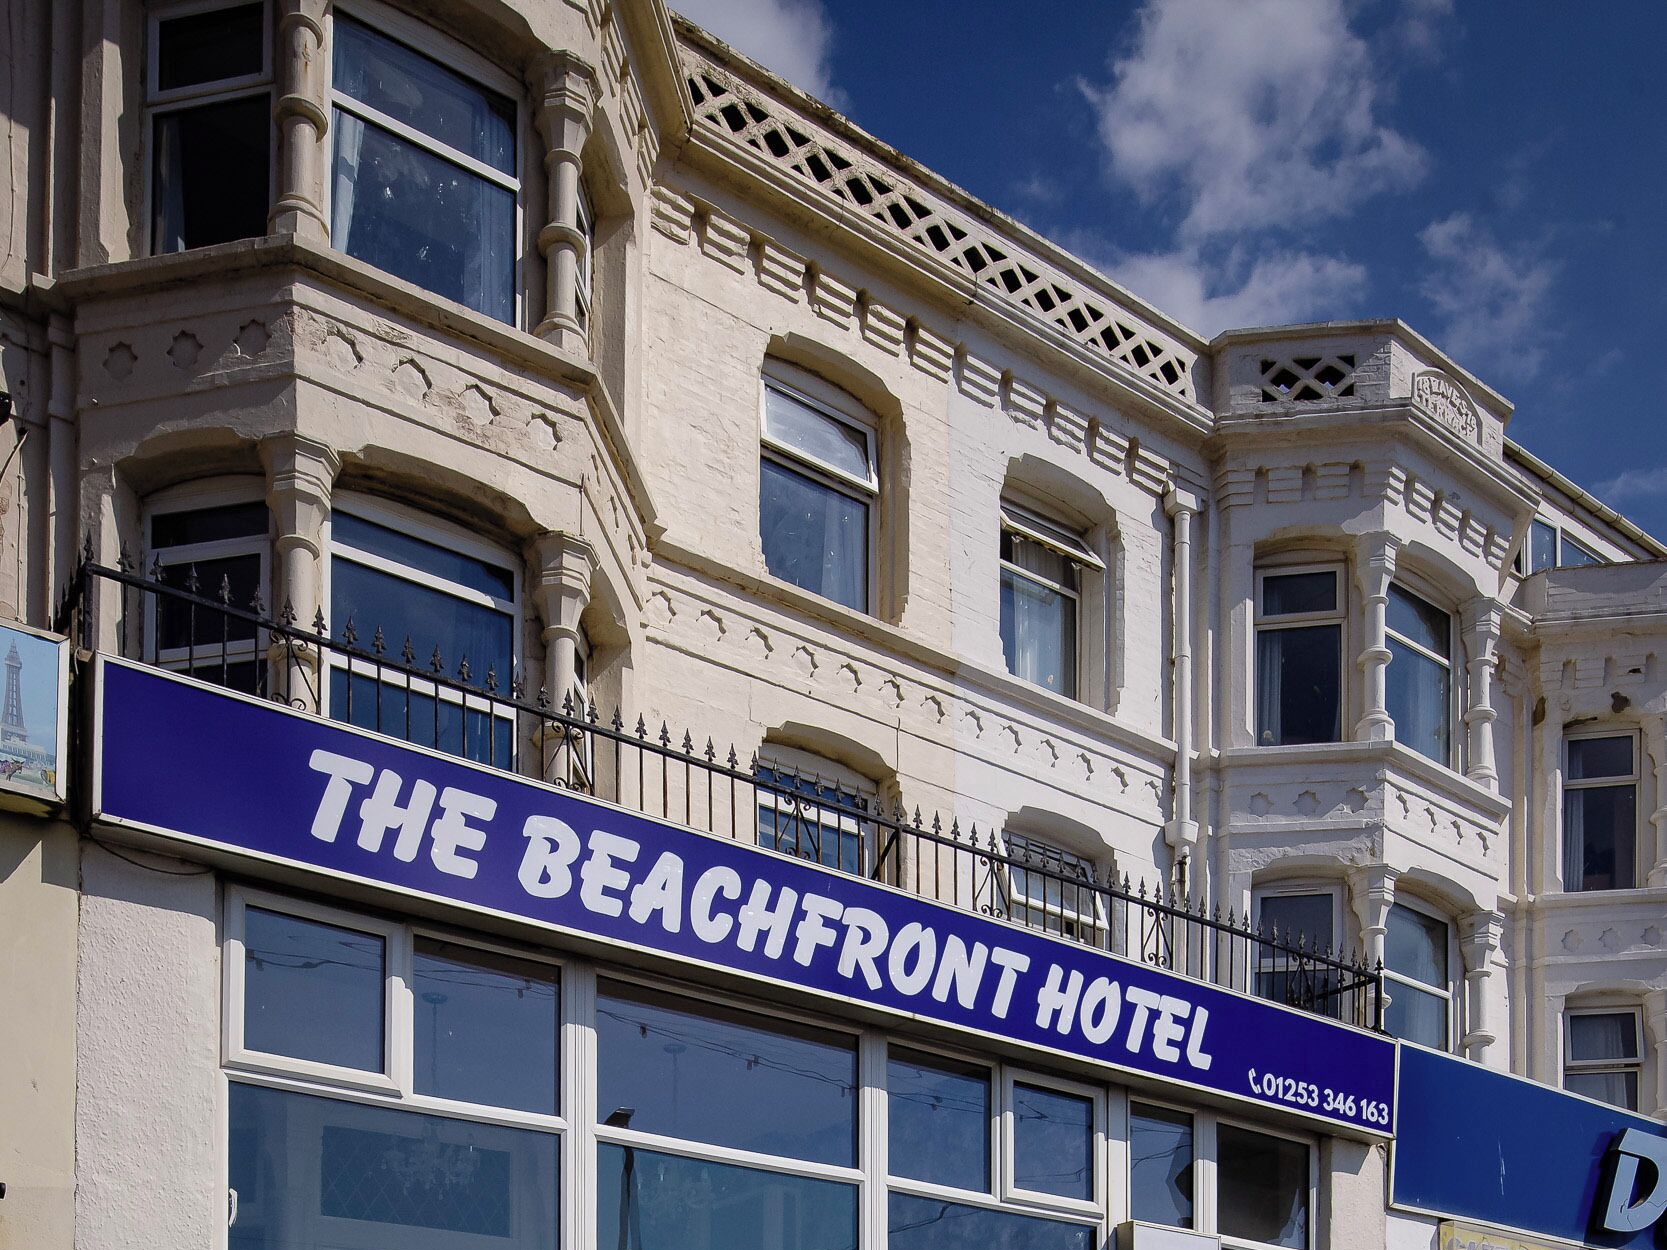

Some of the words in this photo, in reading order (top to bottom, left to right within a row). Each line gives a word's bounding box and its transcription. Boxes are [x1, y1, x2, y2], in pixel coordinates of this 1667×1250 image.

[308, 749, 498, 880] THE
[517, 815, 1030, 1018] BEACHFRONT
[1036, 963, 1212, 1070] HOTEL
[1262, 1073, 1319, 1107] 01253
[1322, 1088, 1356, 1117] 346
[1360, 1099, 1389, 1125] 163
